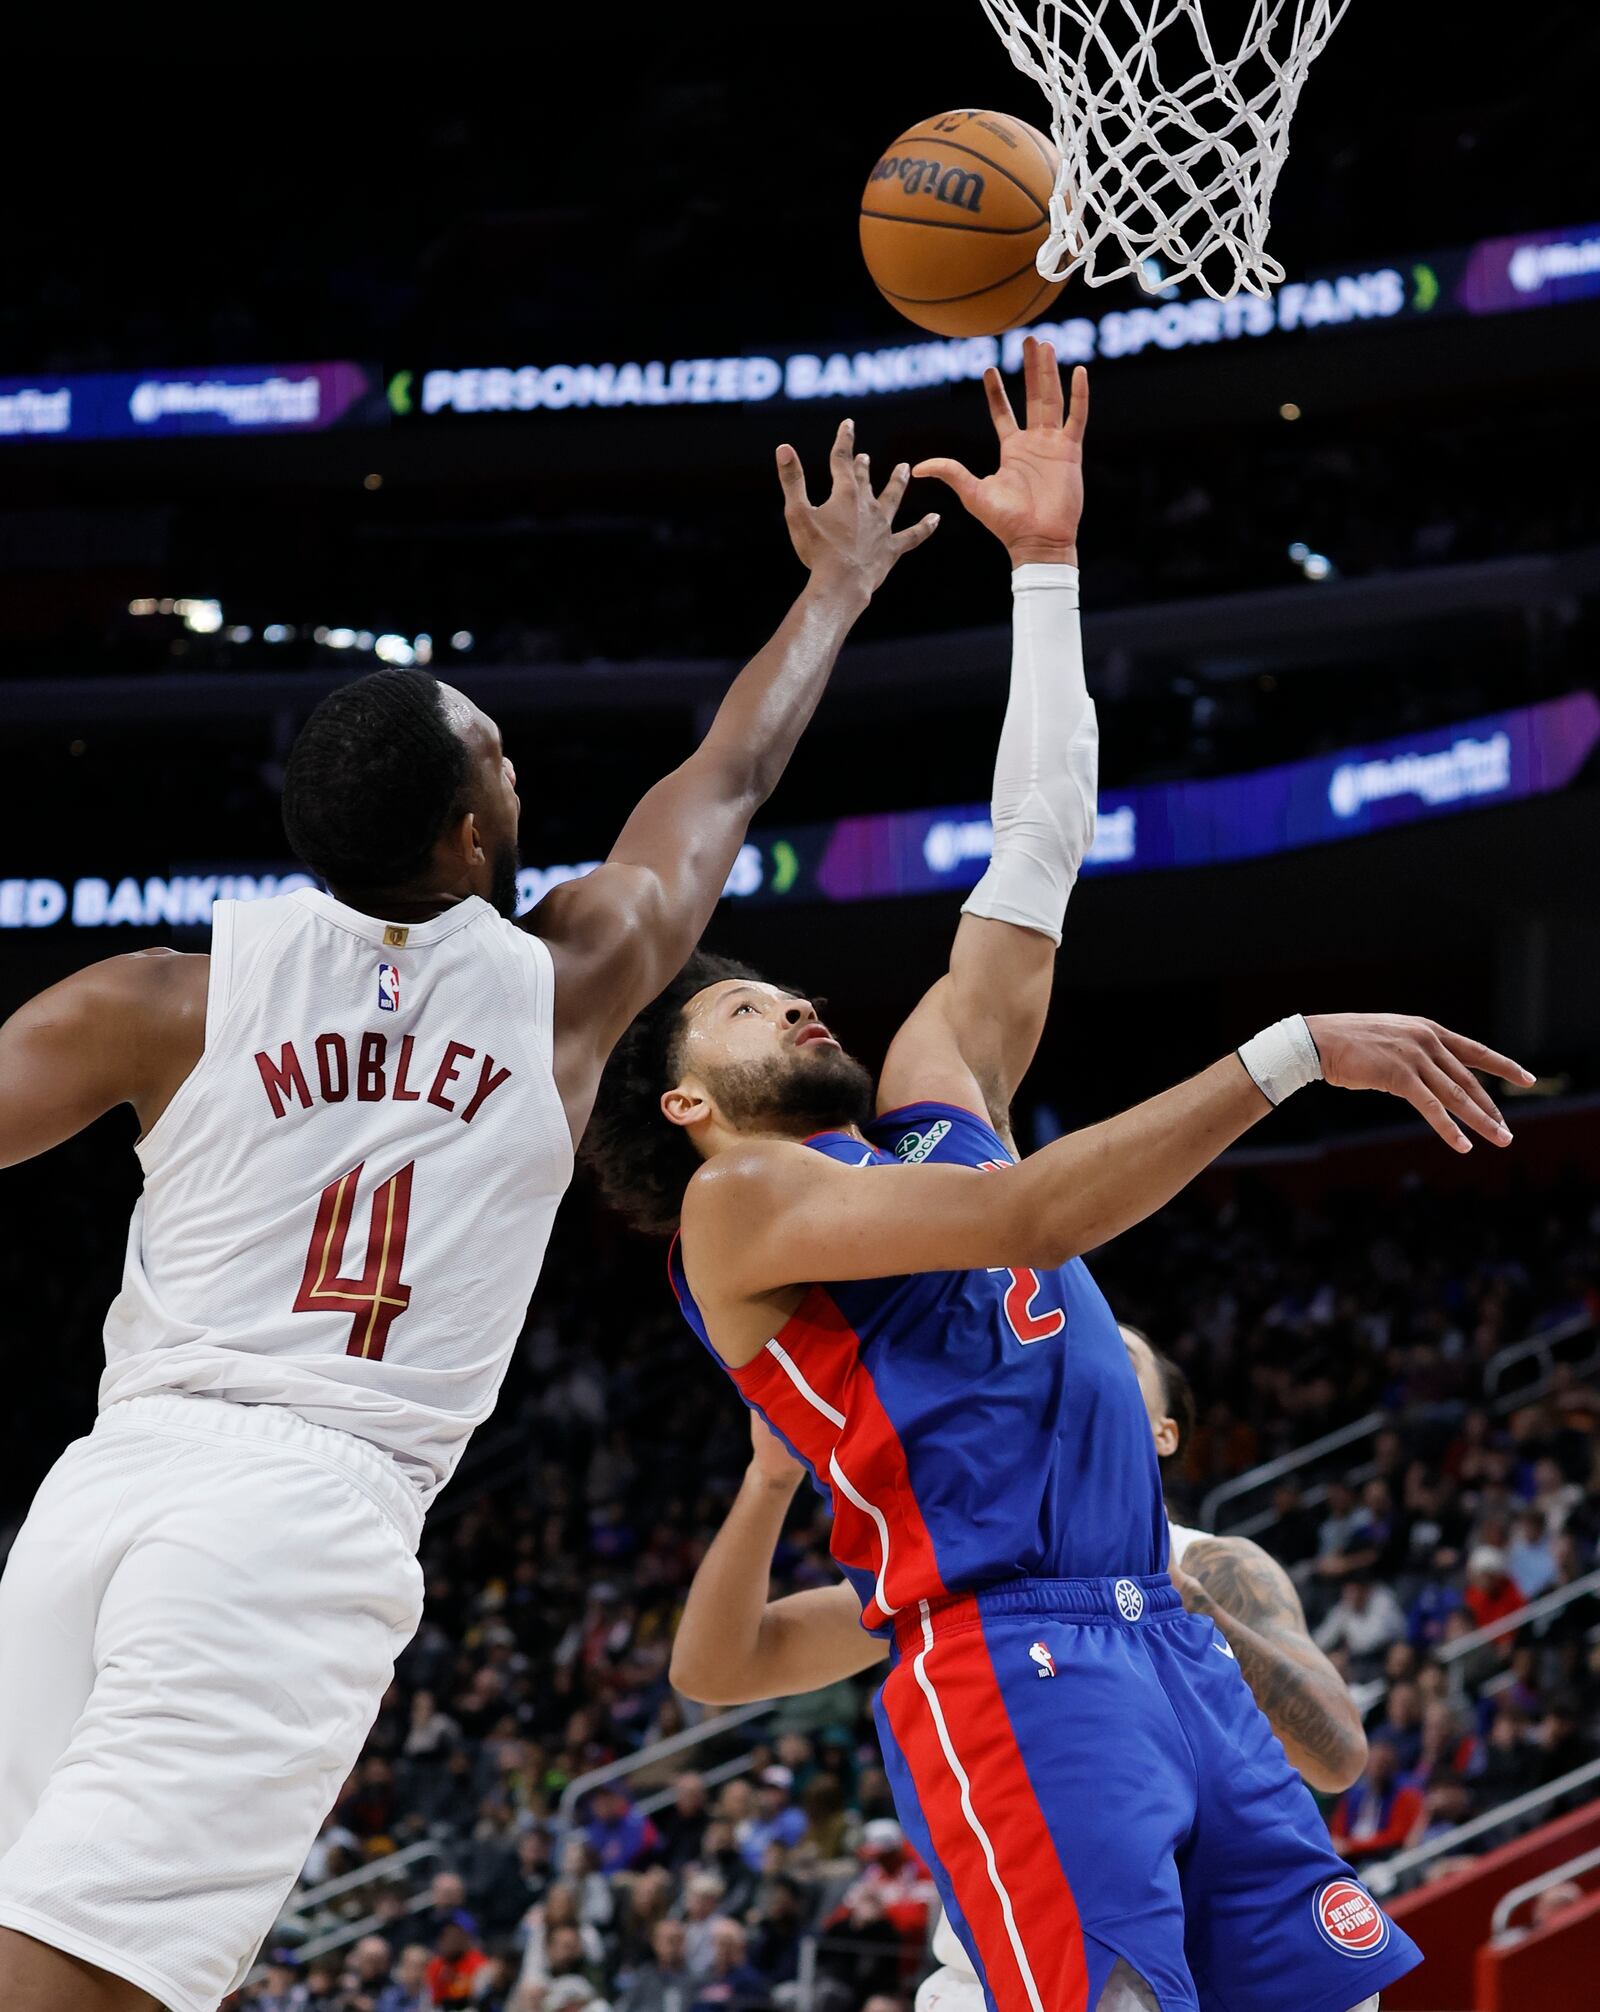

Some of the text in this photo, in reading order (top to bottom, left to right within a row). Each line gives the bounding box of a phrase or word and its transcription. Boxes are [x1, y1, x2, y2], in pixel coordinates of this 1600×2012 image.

[871, 157, 984, 213] Wilson
[422, 357, 780, 413] PERSONALIZED
[785, 336, 998, 398] BANKING
[1099, 291, 1274, 358] SPORTS
[1278, 270, 1403, 328] FANS
[254, 1031, 512, 1124] MOBLEY
[291, 1160, 415, 1362] 4
[995, 1267, 1066, 1346] 2
[1328, 1895, 1366, 1923] DETROIT
[1335, 1908, 1375, 1936] PISTONS
